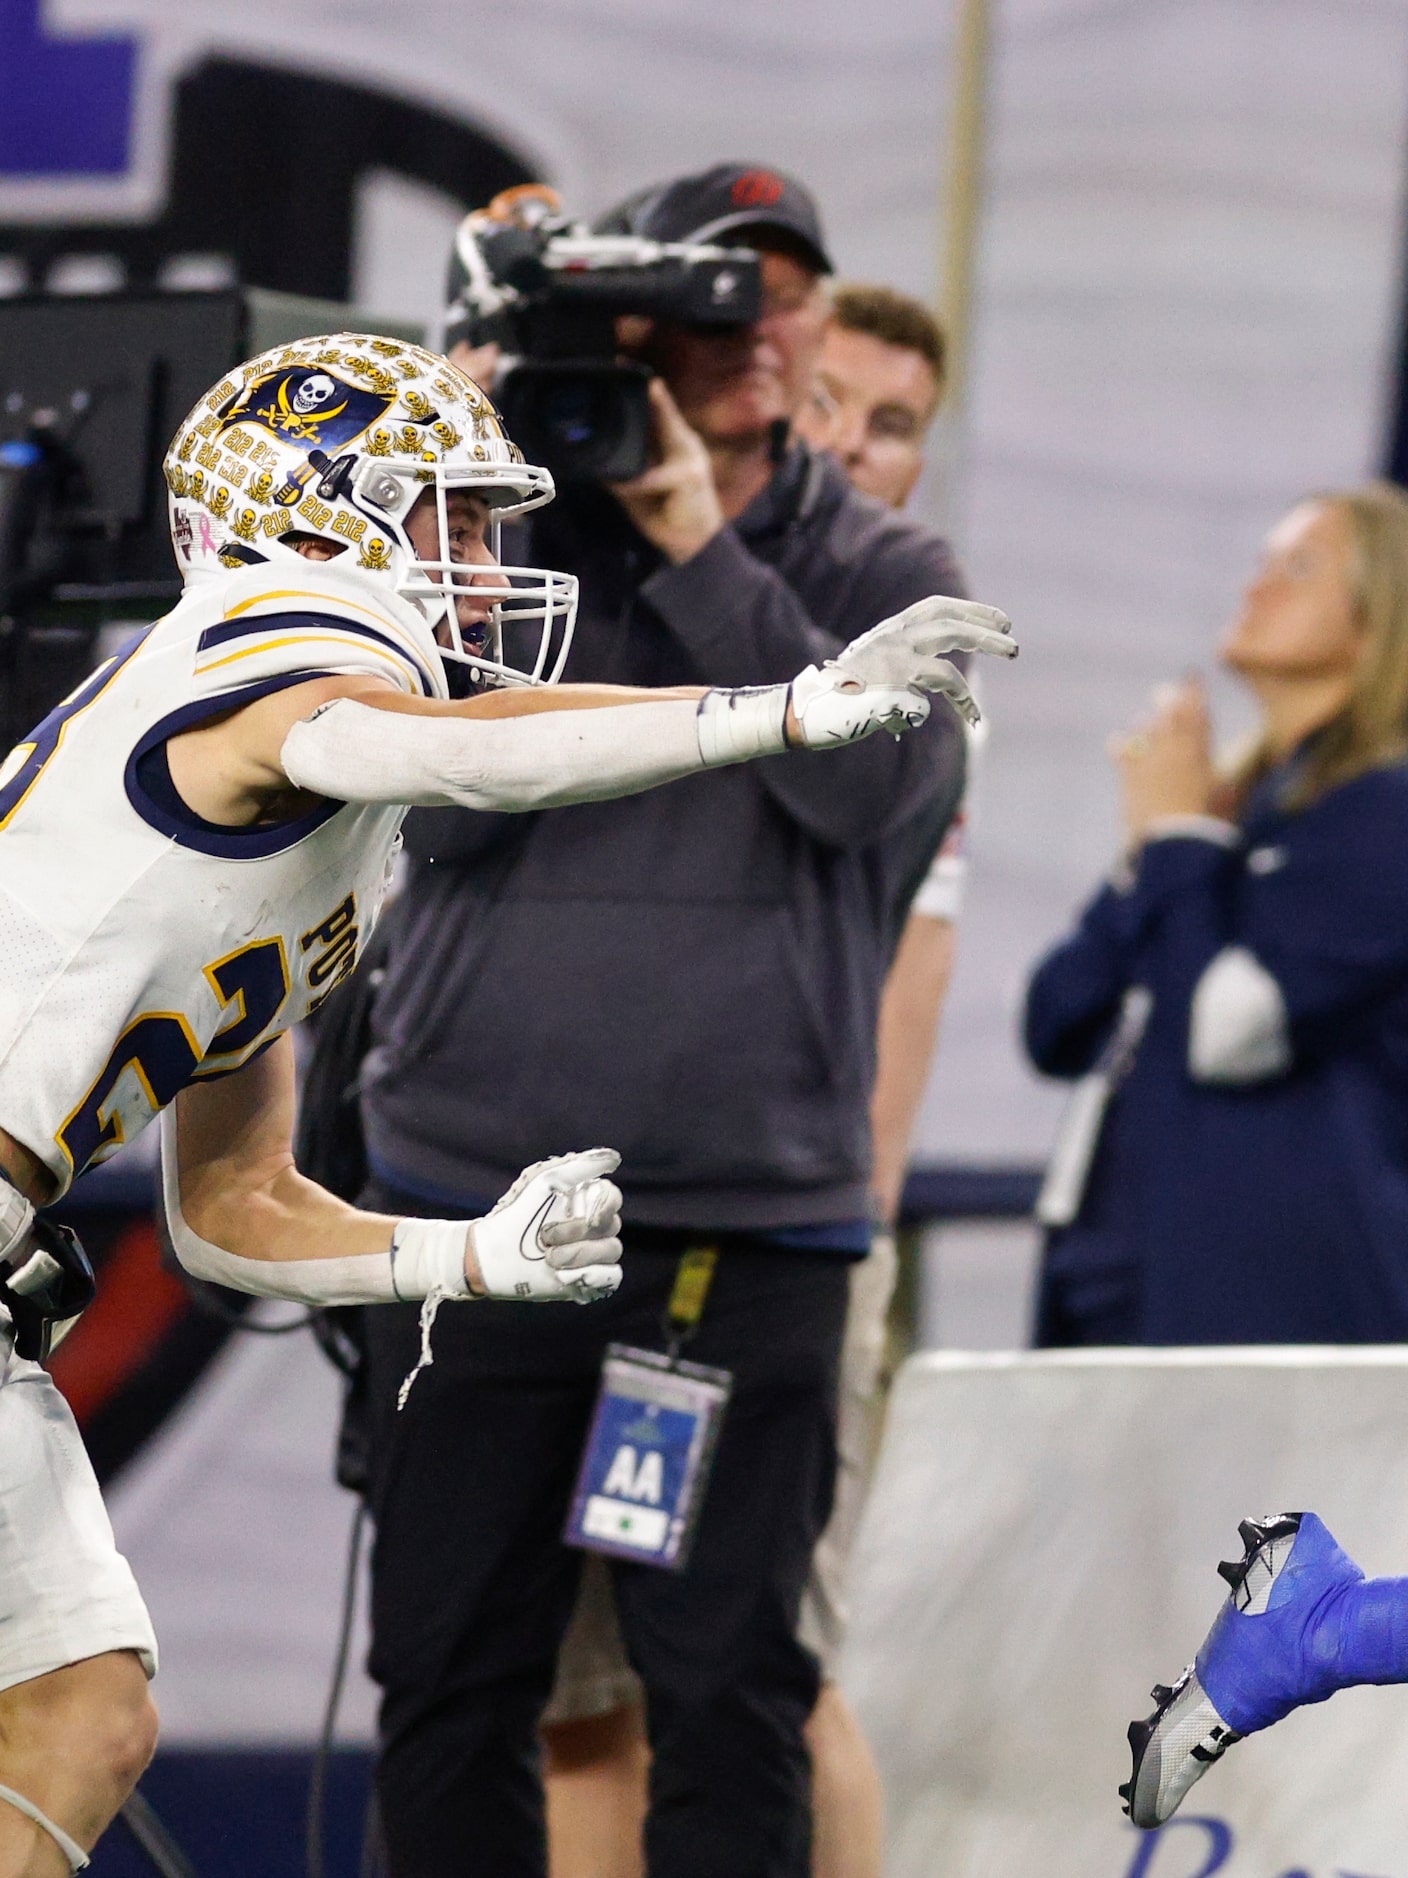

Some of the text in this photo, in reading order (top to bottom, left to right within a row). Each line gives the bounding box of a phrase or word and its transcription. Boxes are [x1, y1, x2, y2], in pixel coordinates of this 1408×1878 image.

[206, 381, 237, 411] 212
[223, 427, 254, 457] 212
[261, 508, 294, 538] 212
[298, 495, 368, 543] 212 212
[603, 1445, 665, 1505] AA
